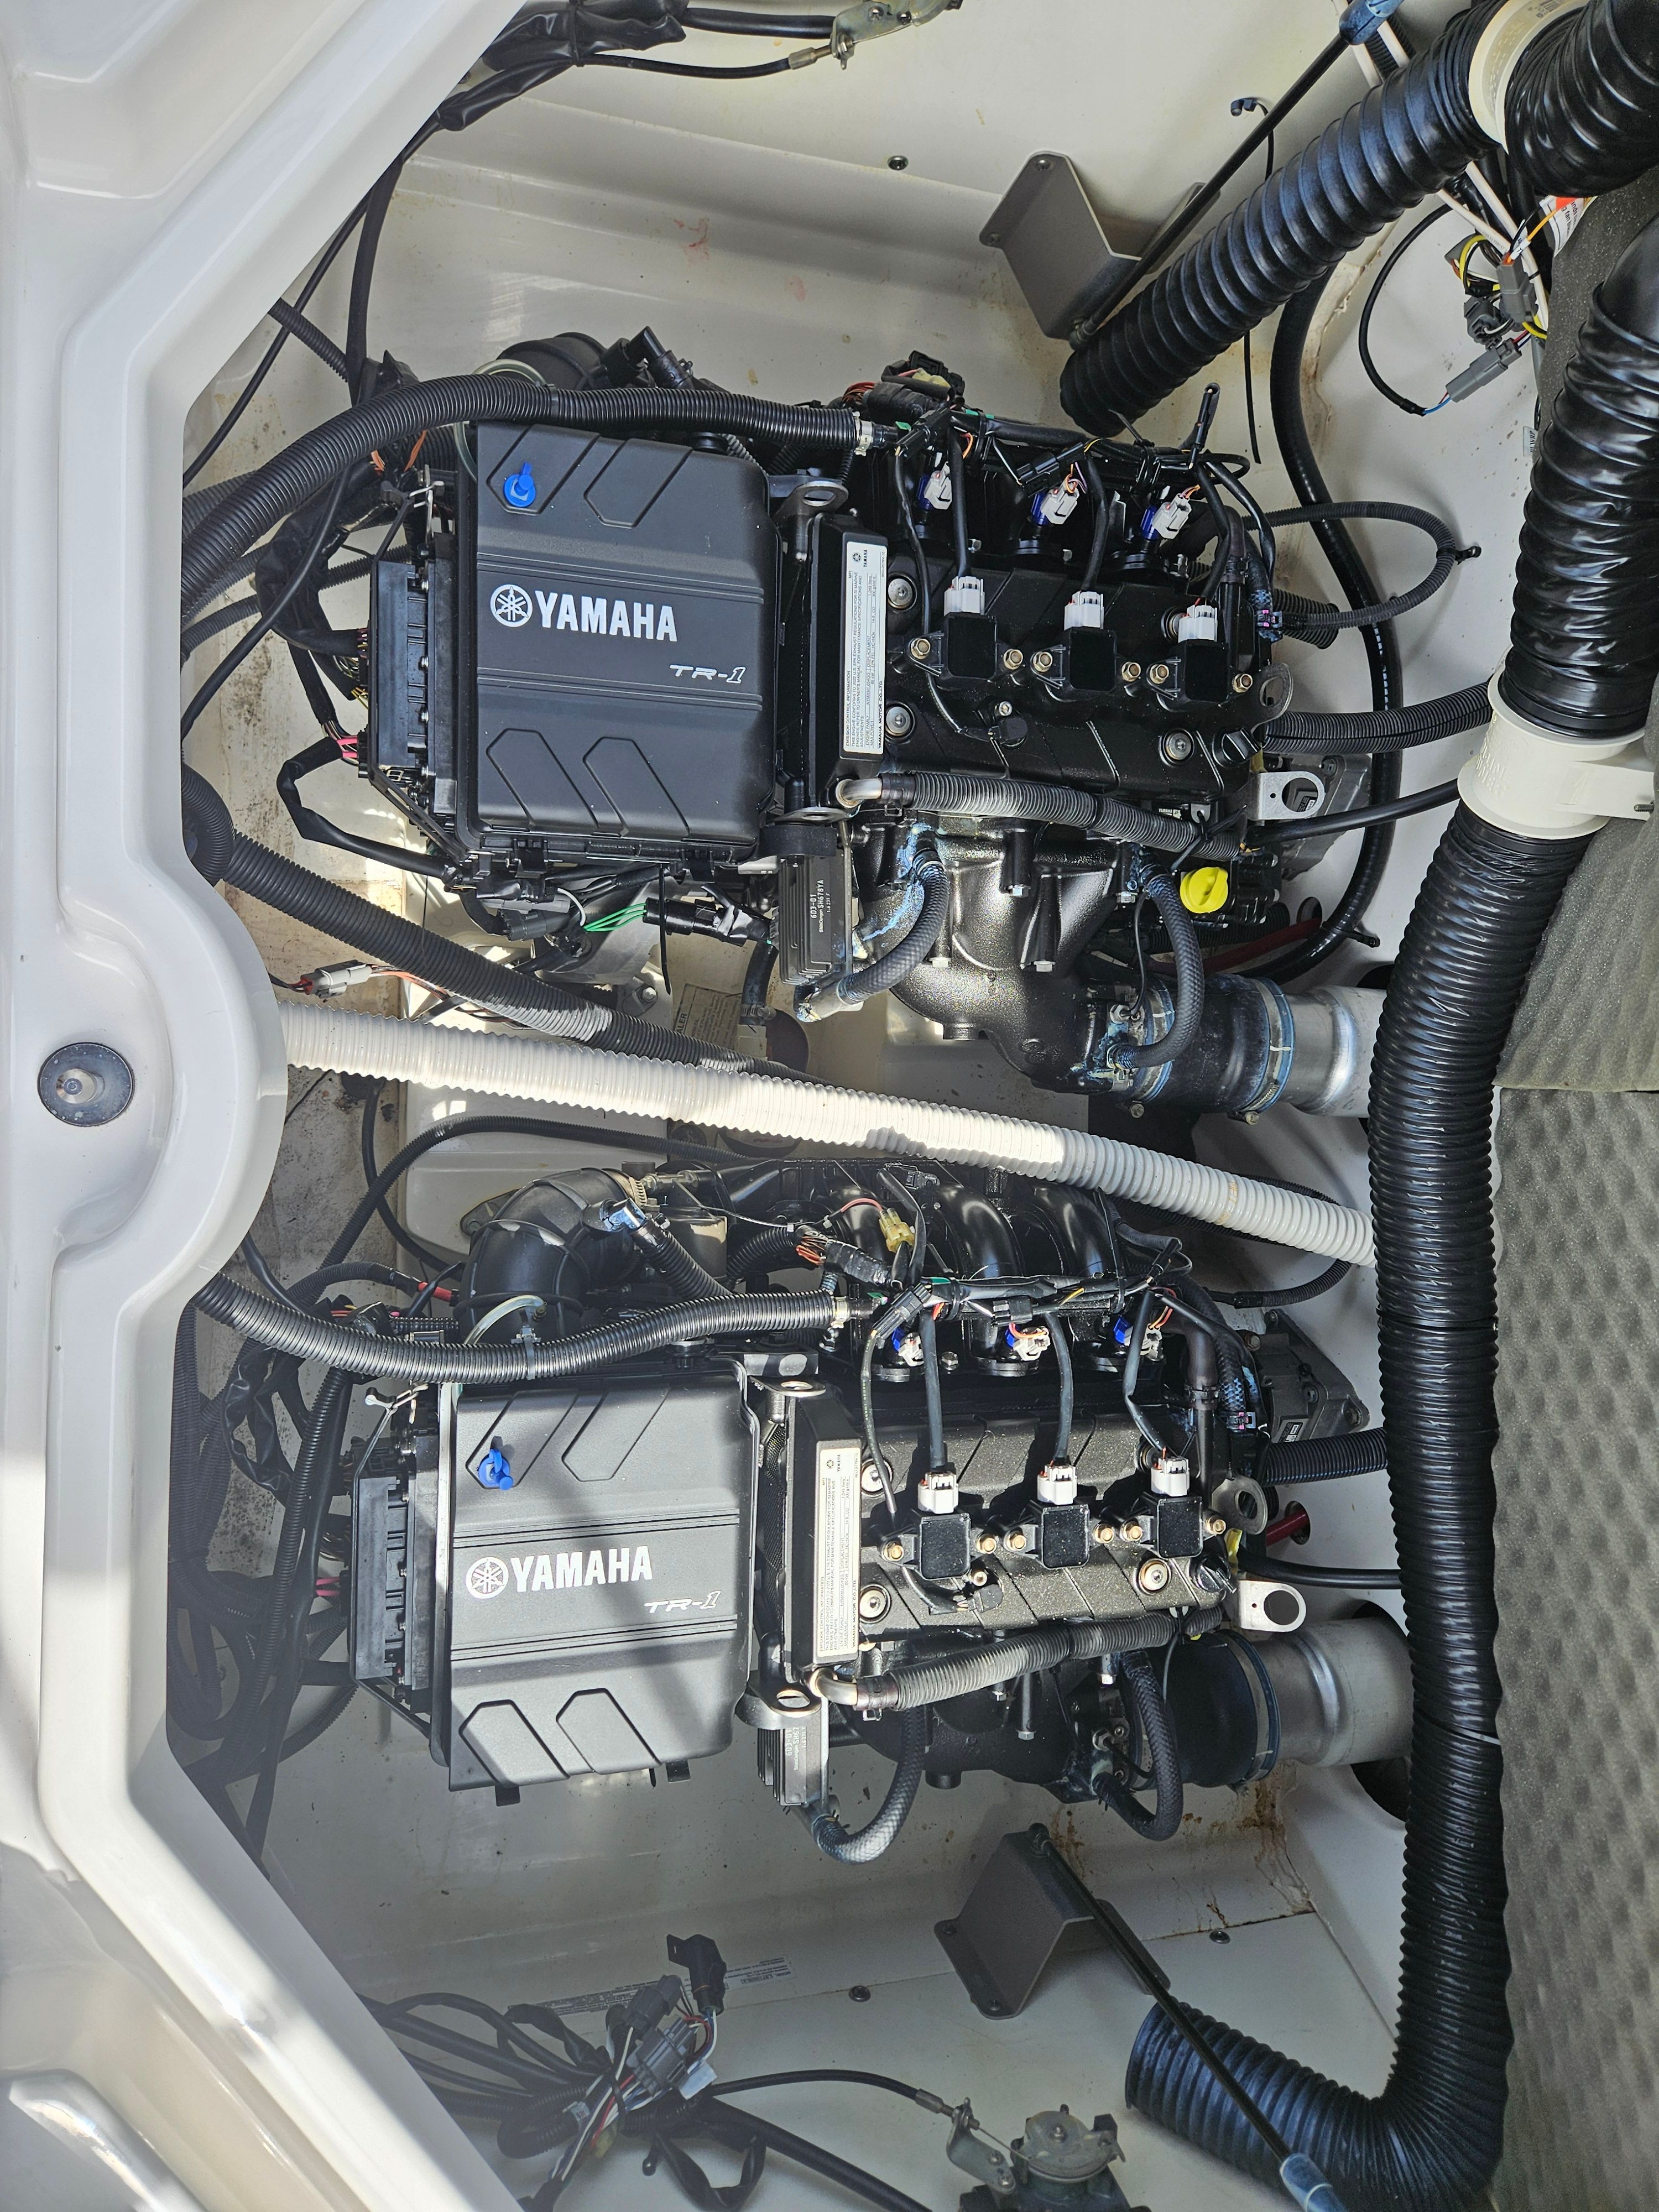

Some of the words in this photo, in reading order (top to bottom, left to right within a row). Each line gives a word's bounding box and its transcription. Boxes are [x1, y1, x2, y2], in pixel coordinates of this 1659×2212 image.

[535, 591, 677, 642] YAMAHA
[670, 665, 747, 684] TR-1
[510, 1546, 653, 1592] YAMAHA
[644, 1590, 721, 1613] TR-1
